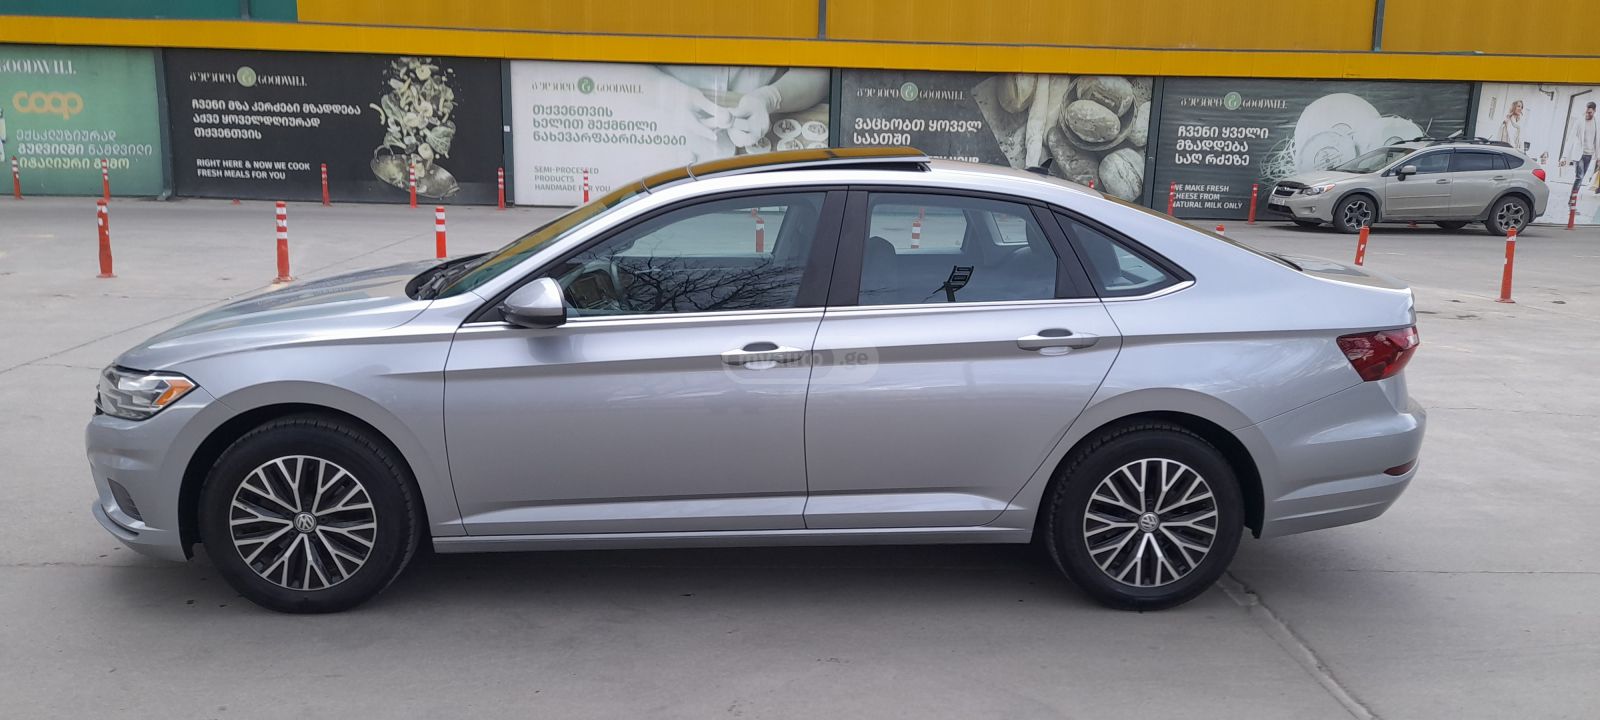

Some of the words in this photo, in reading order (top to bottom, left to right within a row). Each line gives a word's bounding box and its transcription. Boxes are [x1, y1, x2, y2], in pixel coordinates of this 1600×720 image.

[257, 75, 307, 87] GOODWILL
[596, 83, 644, 94] GOODWILL
[919, 90, 965, 100] GOODWILL
[12, 91, 84, 120] coop
[192, 99, 226, 110] ჩვენი
[228, 100, 250, 111] მზა
[251, 101, 301, 113] კერძები
[302, 102, 361, 115] მზადდება
[1242, 99, 1288, 109] GOODWILL
[532, 104, 613, 118] თქვენთვის
[193, 113, 220, 124] აქვე
[222, 114, 321, 127] ყოველდღიურად
[533, 118, 584, 129] ხელით
[587, 119, 658, 131] შექმნილი
[855, 117, 925, 131] ვაცხობთ
[928, 119, 982, 133] ყოველ
[16, 129, 117, 142] ექსკლუზიურად
[194, 127, 262, 140] თქვენთვის
[533, 131, 687, 146] ნახევარფაბრიკატები
[1178, 125, 1219, 138] ჩვენი
[1221, 126, 1269, 139] ყველი
[853, 132, 911, 146] საათში
[1176, 139, 1249, 152] მზადდება
[18, 143, 84, 156] გუდვილში
[88, 144, 153, 156] ნამდვილი
[19, 157, 90, 169] იტალიური
[93, 157, 130, 169] გმო
[196, 159, 221, 168] RIGHT
[222, 160, 243, 168] HERE
[245, 161, 252, 169] &
[253, 161, 273, 170] NOW
[273, 162, 287, 170] WE
[288, 162, 311, 171] COOK
[1175, 153, 1202, 164] საღ
[1205, 154, 1250, 166] რძეზე
[197, 168, 223, 178] FRESH
[224, 169, 250, 179] MEALS
[251, 171, 268, 179] FOR
[269, 171, 286, 180] YOU
[534, 166, 599, 174] SEMI-PROCESED
[534, 183, 576, 191] HANDMADE
[1184, 184, 1205, 192] MAKE
[1199, 193, 1220, 201] FROM
